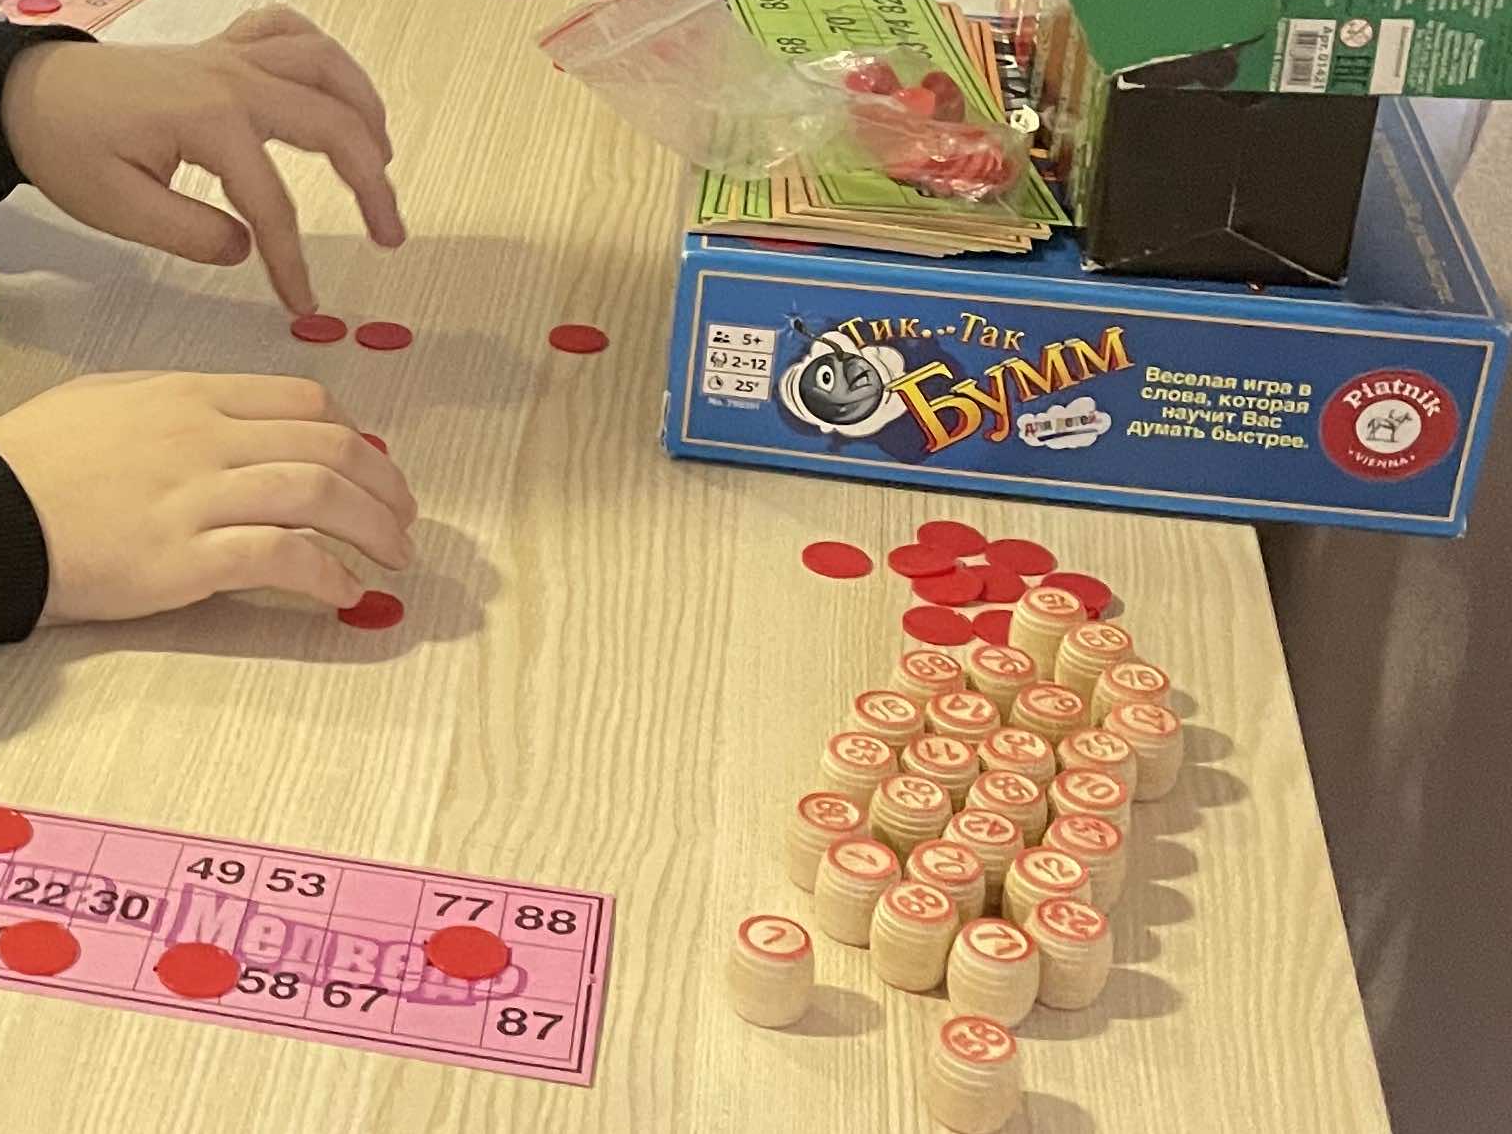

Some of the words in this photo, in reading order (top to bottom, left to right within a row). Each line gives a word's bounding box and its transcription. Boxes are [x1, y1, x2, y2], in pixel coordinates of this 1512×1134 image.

[826, 16, 861, 34] 70
[742, 333, 762, 346] 5+
[731, 356, 767, 371] 2-12
[1145, 366, 1237, 390] Веселая
[1244, 378, 1294, 397] игра
[1299, 384, 1313, 396] в
[1140, 386, 1212, 407] слова,
[1219, 393, 1310, 415] которая
[1343, 378, 1443, 417] Platnik
[1162, 405, 1234, 425] научит
[1242, 410, 1282, 428] Вас
[1127, 418, 1205, 442] думать
[1211, 424, 1309, 449] быстрее.
[8, 876, 71, 908] 22
[88, 888, 150, 921] 30
[186, 855, 246, 886] 49
[265, 867, 327, 899] 53
[432, 891, 494, 923] 77
[514, 904, 578, 936] 88
[237, 967, 300, 1000] 58
[322, 981, 389, 1013] 67
[496, 1006, 564, 1040] 87
